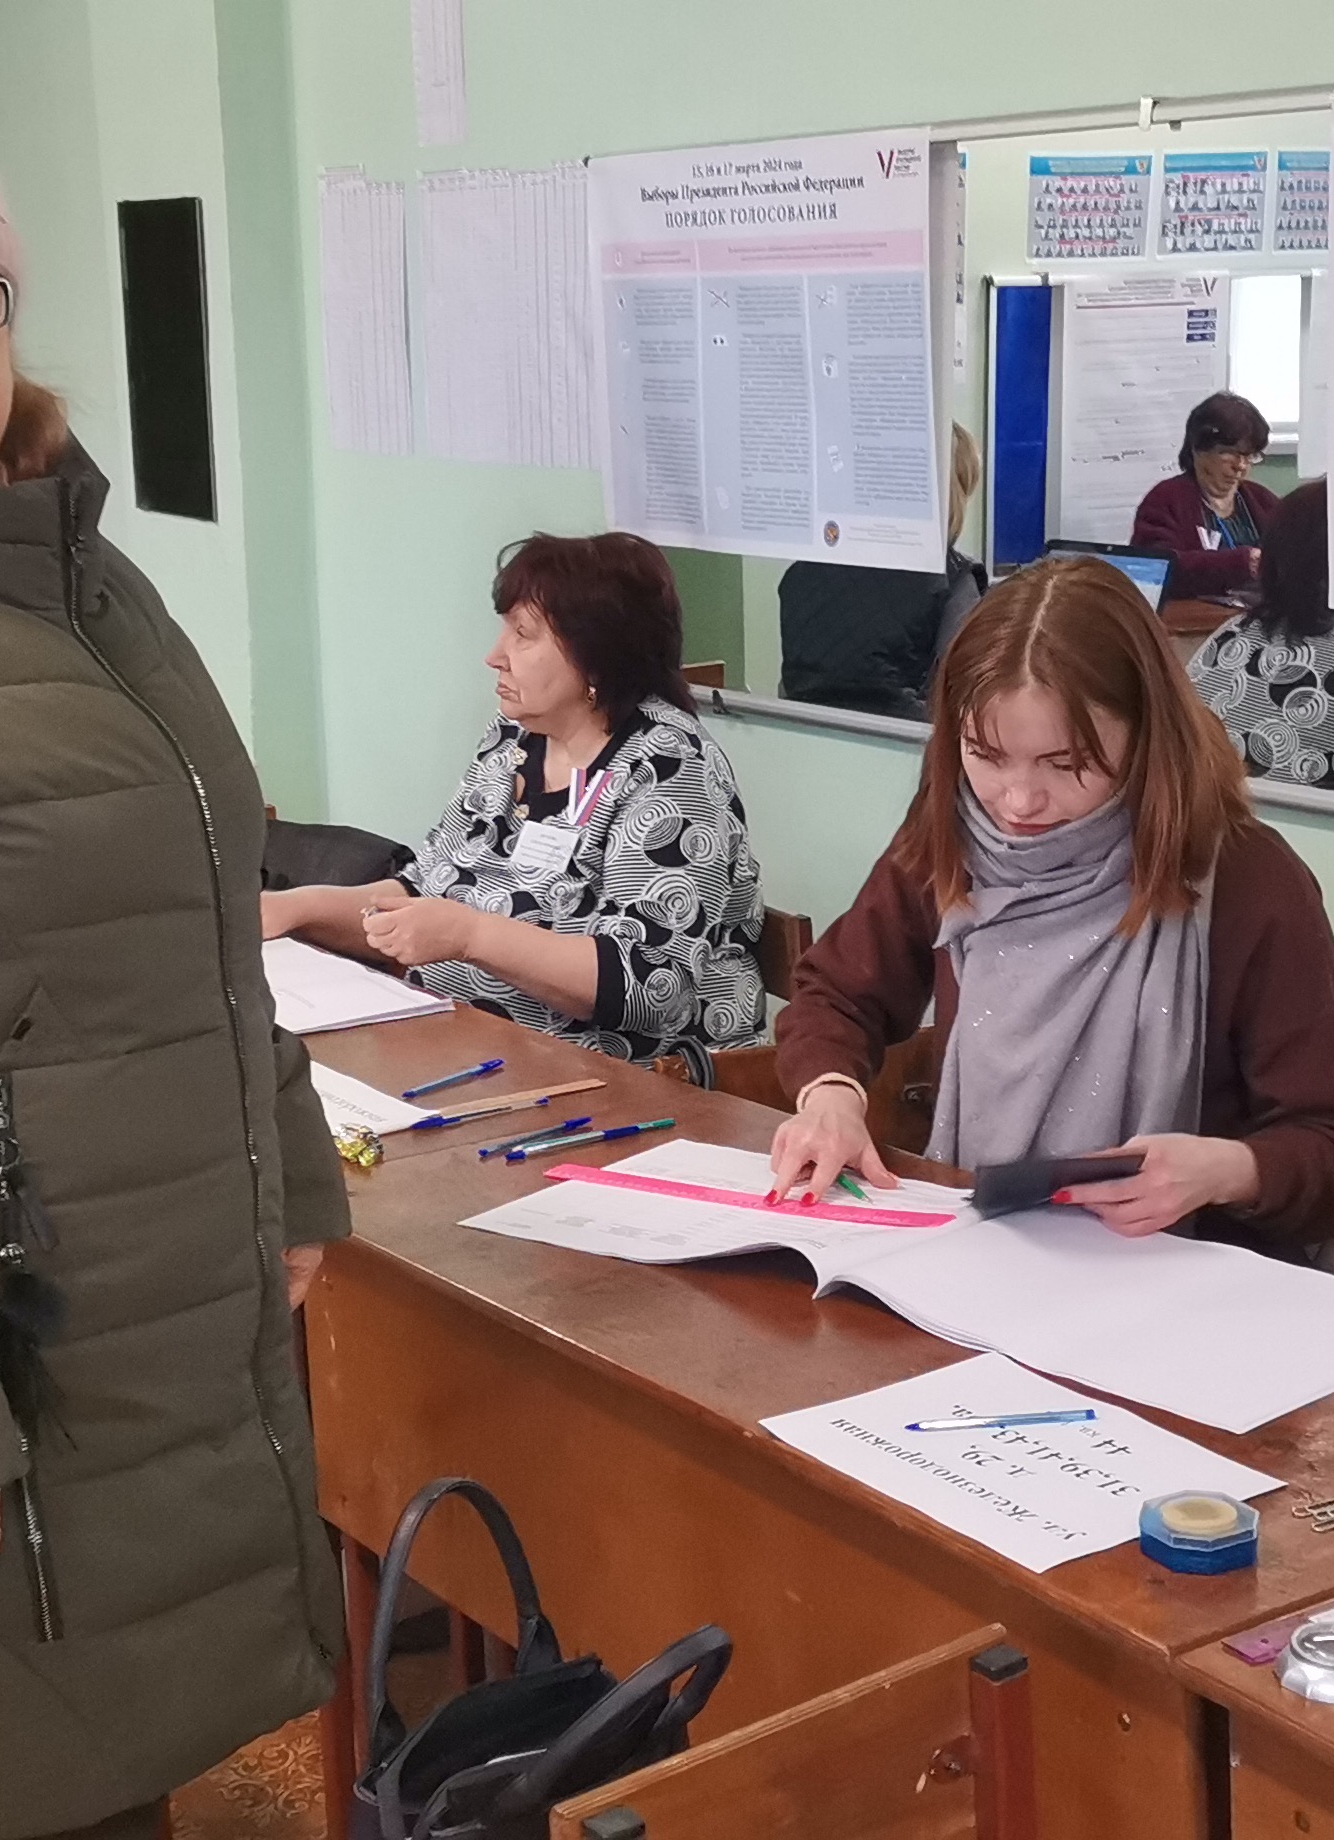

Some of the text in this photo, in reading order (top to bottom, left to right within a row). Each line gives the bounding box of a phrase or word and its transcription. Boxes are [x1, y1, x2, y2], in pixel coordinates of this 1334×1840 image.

[640, 174, 865, 206] Выборы Президента Российской Федерации
[665, 201, 838, 230] ПОРЯДОК ГОЛОСОВАНИЯ
[828, 1418, 1040, 1523] Железнодорожная
